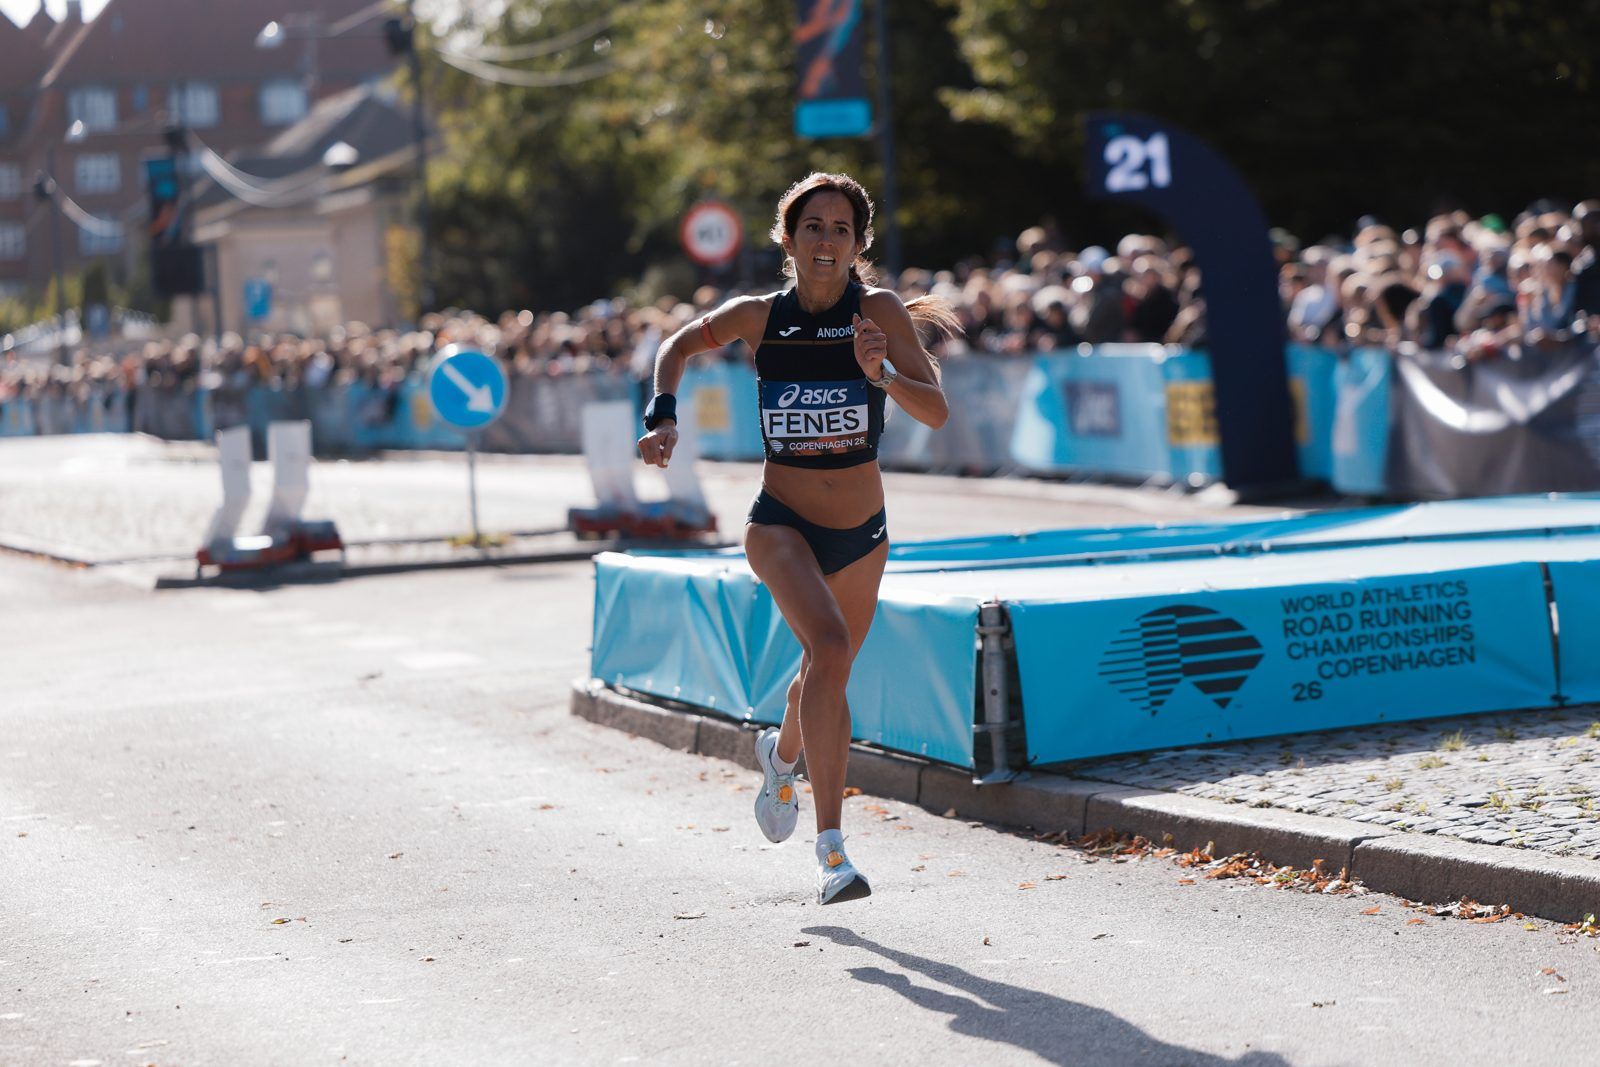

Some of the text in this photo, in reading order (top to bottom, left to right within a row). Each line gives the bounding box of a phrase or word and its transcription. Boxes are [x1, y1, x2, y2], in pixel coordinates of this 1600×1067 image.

[1103, 131, 1171, 193] 21
[817, 325, 855, 338] ANDOR
[768, 409, 860, 434] FENES
[789, 437, 865, 451] COPENHAGEN 26
[1281, 580, 1468, 614] WORLD ATHLETICS
[1283, 601, 1472, 638] ROAD RUNNING
[1287, 623, 1474, 660] CHAMPIONSHIPS
[1318, 645, 1476, 679] COPENHAGEN
[1292, 681, 1323, 702] 26
